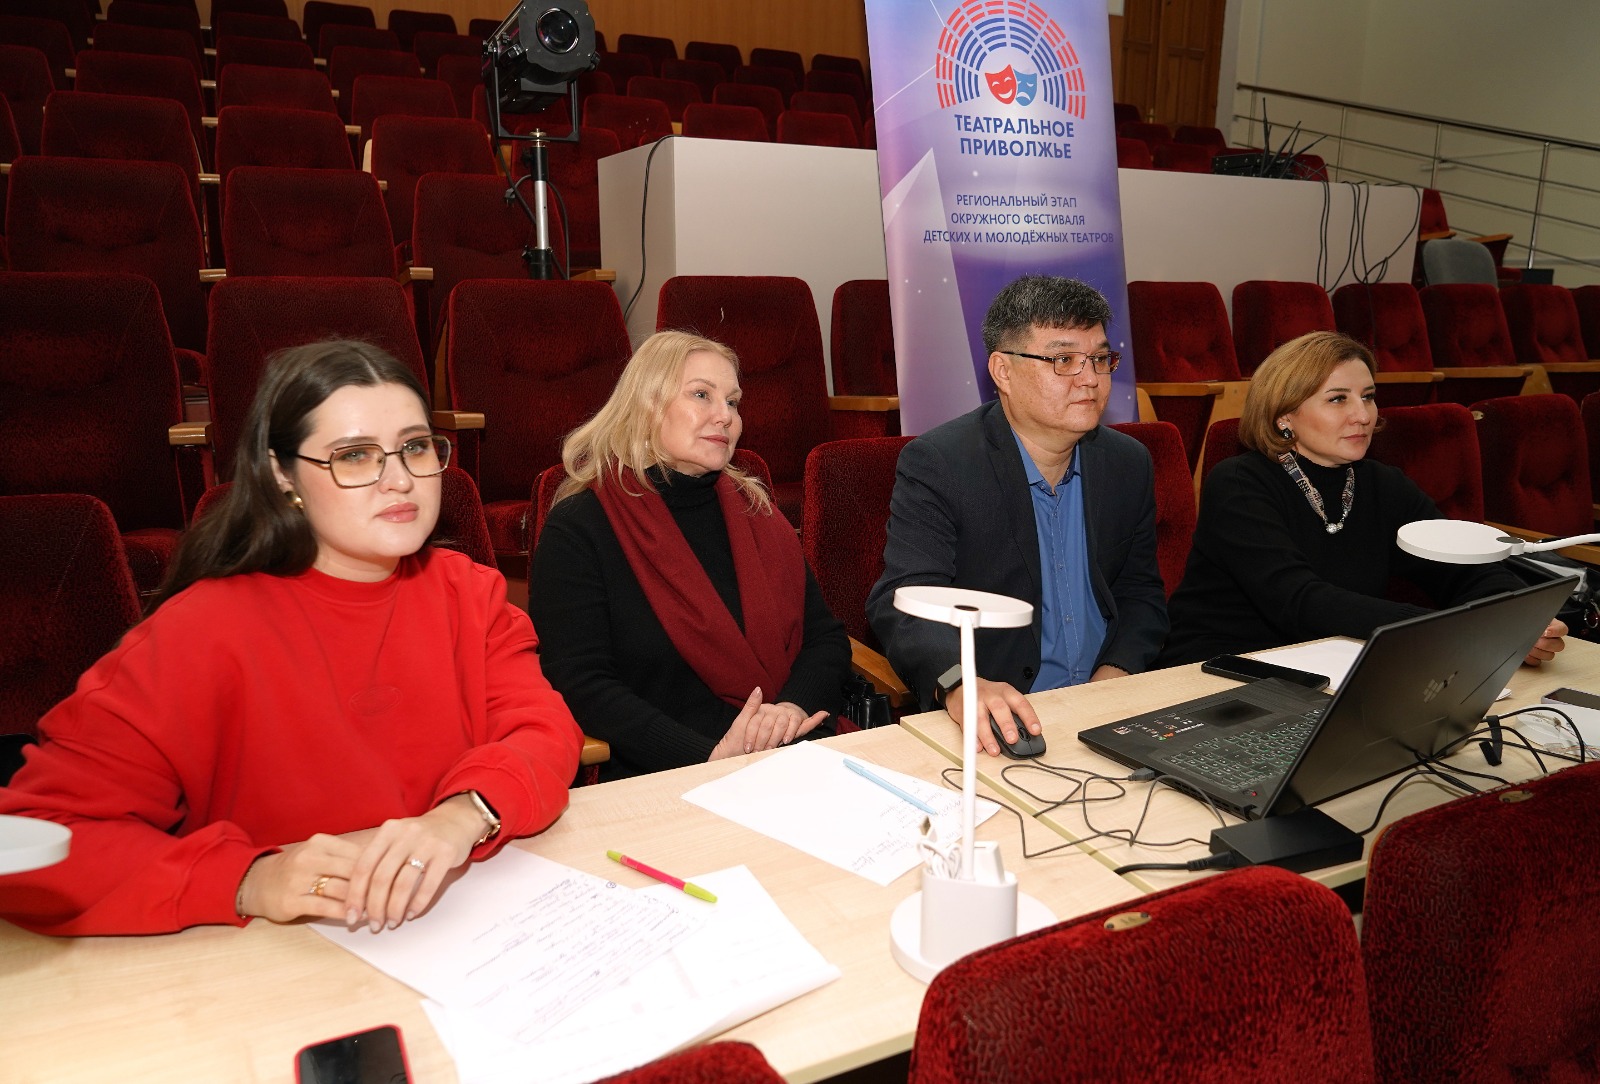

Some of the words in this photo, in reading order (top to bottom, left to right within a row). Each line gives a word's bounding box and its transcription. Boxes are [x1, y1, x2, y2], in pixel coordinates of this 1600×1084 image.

[954, 114, 1075, 138] ТЕАТРАЛЬНОЕ
[960, 137, 1072, 159] ПРИВОЛЖЬЕ
[956, 193, 1048, 207] РЕГИОНАЛЬНЫЙ
[1051, 196, 1077, 208] ЭТАП
[951, 213, 1021, 225] ОКРУЖНОГО
[1024, 214, 1085, 226] ФЕСТИВАЛЯ
[923, 230, 971, 243] ДЕТСКИХ
[973, 232, 983, 243] И
[985, 230, 1068, 245] МОЛОДЁЖНЫХ
[1070, 232, 1114, 243] ТЕАТРОВ
